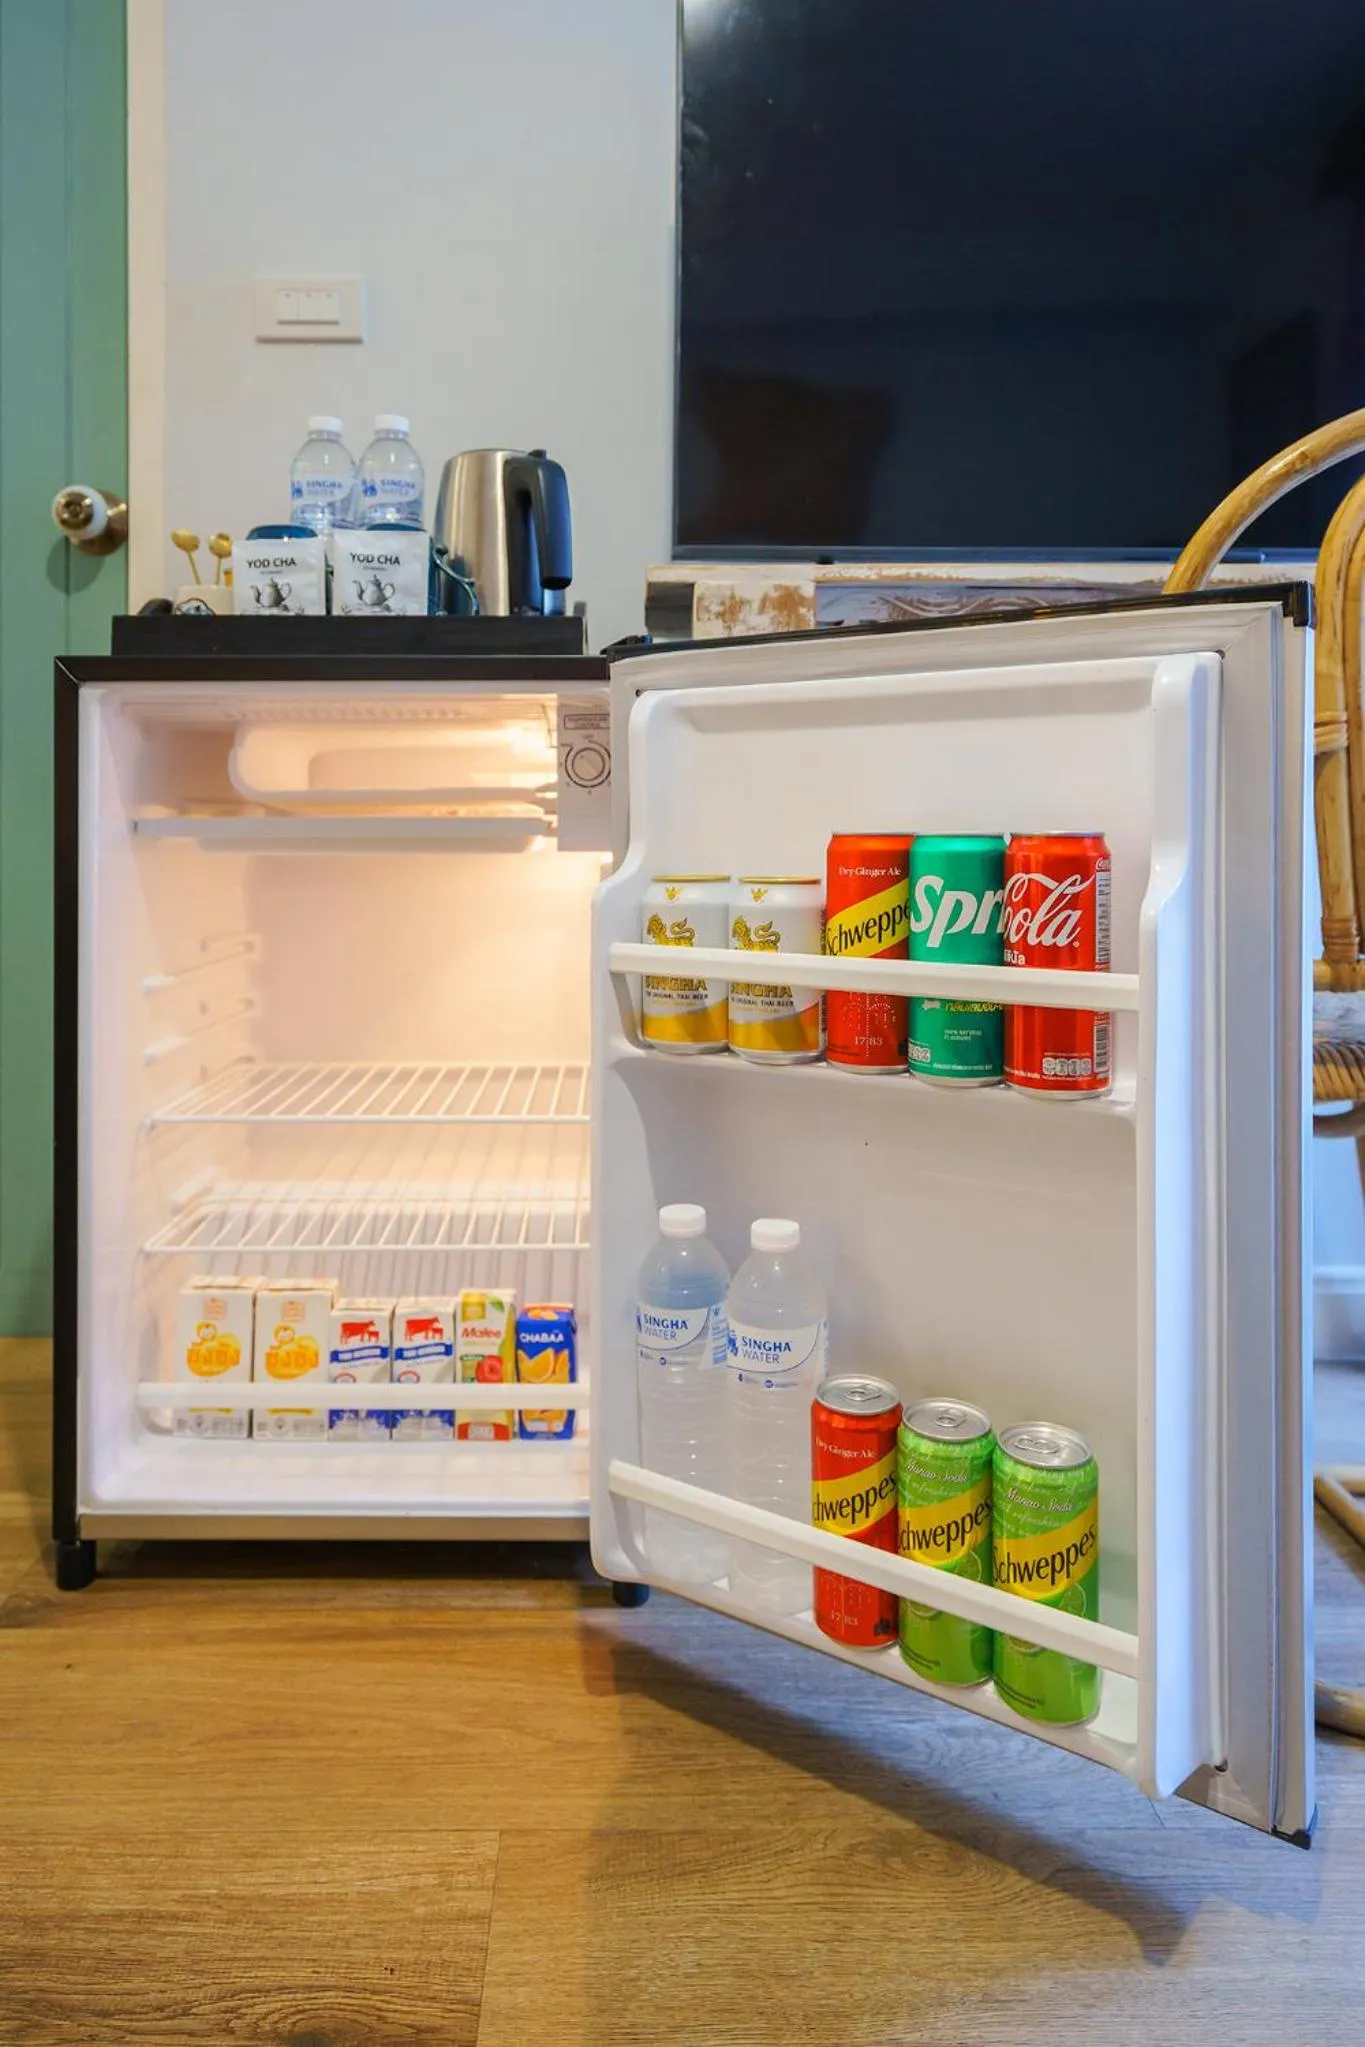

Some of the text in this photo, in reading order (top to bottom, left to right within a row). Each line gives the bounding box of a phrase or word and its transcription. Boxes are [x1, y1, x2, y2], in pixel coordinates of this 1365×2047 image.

[247, 557, 298, 569] YOD CHA
[350, 552, 401, 566] YOD CHA
[839, 866, 902, 877] Dry Ginger Ale
[643, 1313, 689, 1331] SINGHA
[462, 1327, 503, 1339] Malee
[519, 1331, 565, 1343] CHABAA
[644, 1327, 677, 1342] WATER
[741, 1335, 792, 1353] SINGHA
[742, 1349, 780, 1365] WATER
[829, 1443, 858, 1459] Ginger
[859, 1449, 875, 1459] Ale
